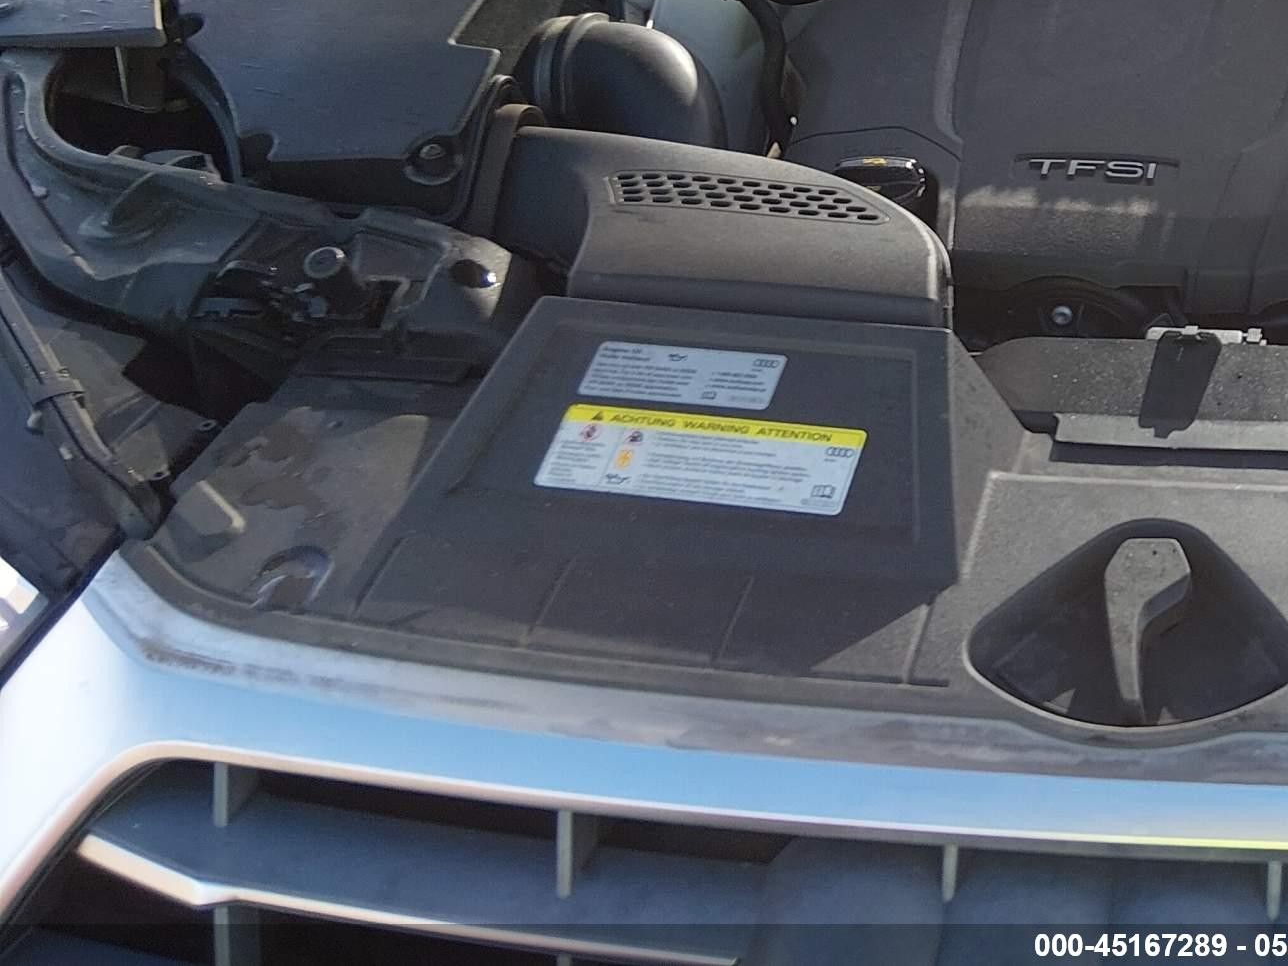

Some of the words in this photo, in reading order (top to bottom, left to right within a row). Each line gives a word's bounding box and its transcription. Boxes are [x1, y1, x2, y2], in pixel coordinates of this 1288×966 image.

[1029, 158, 1158, 180] TFSI
[610, 414, 676, 427] ACHTUNG
[684, 420, 751, 435] WARNING
[756, 426, 833, 442] ATTENTION
